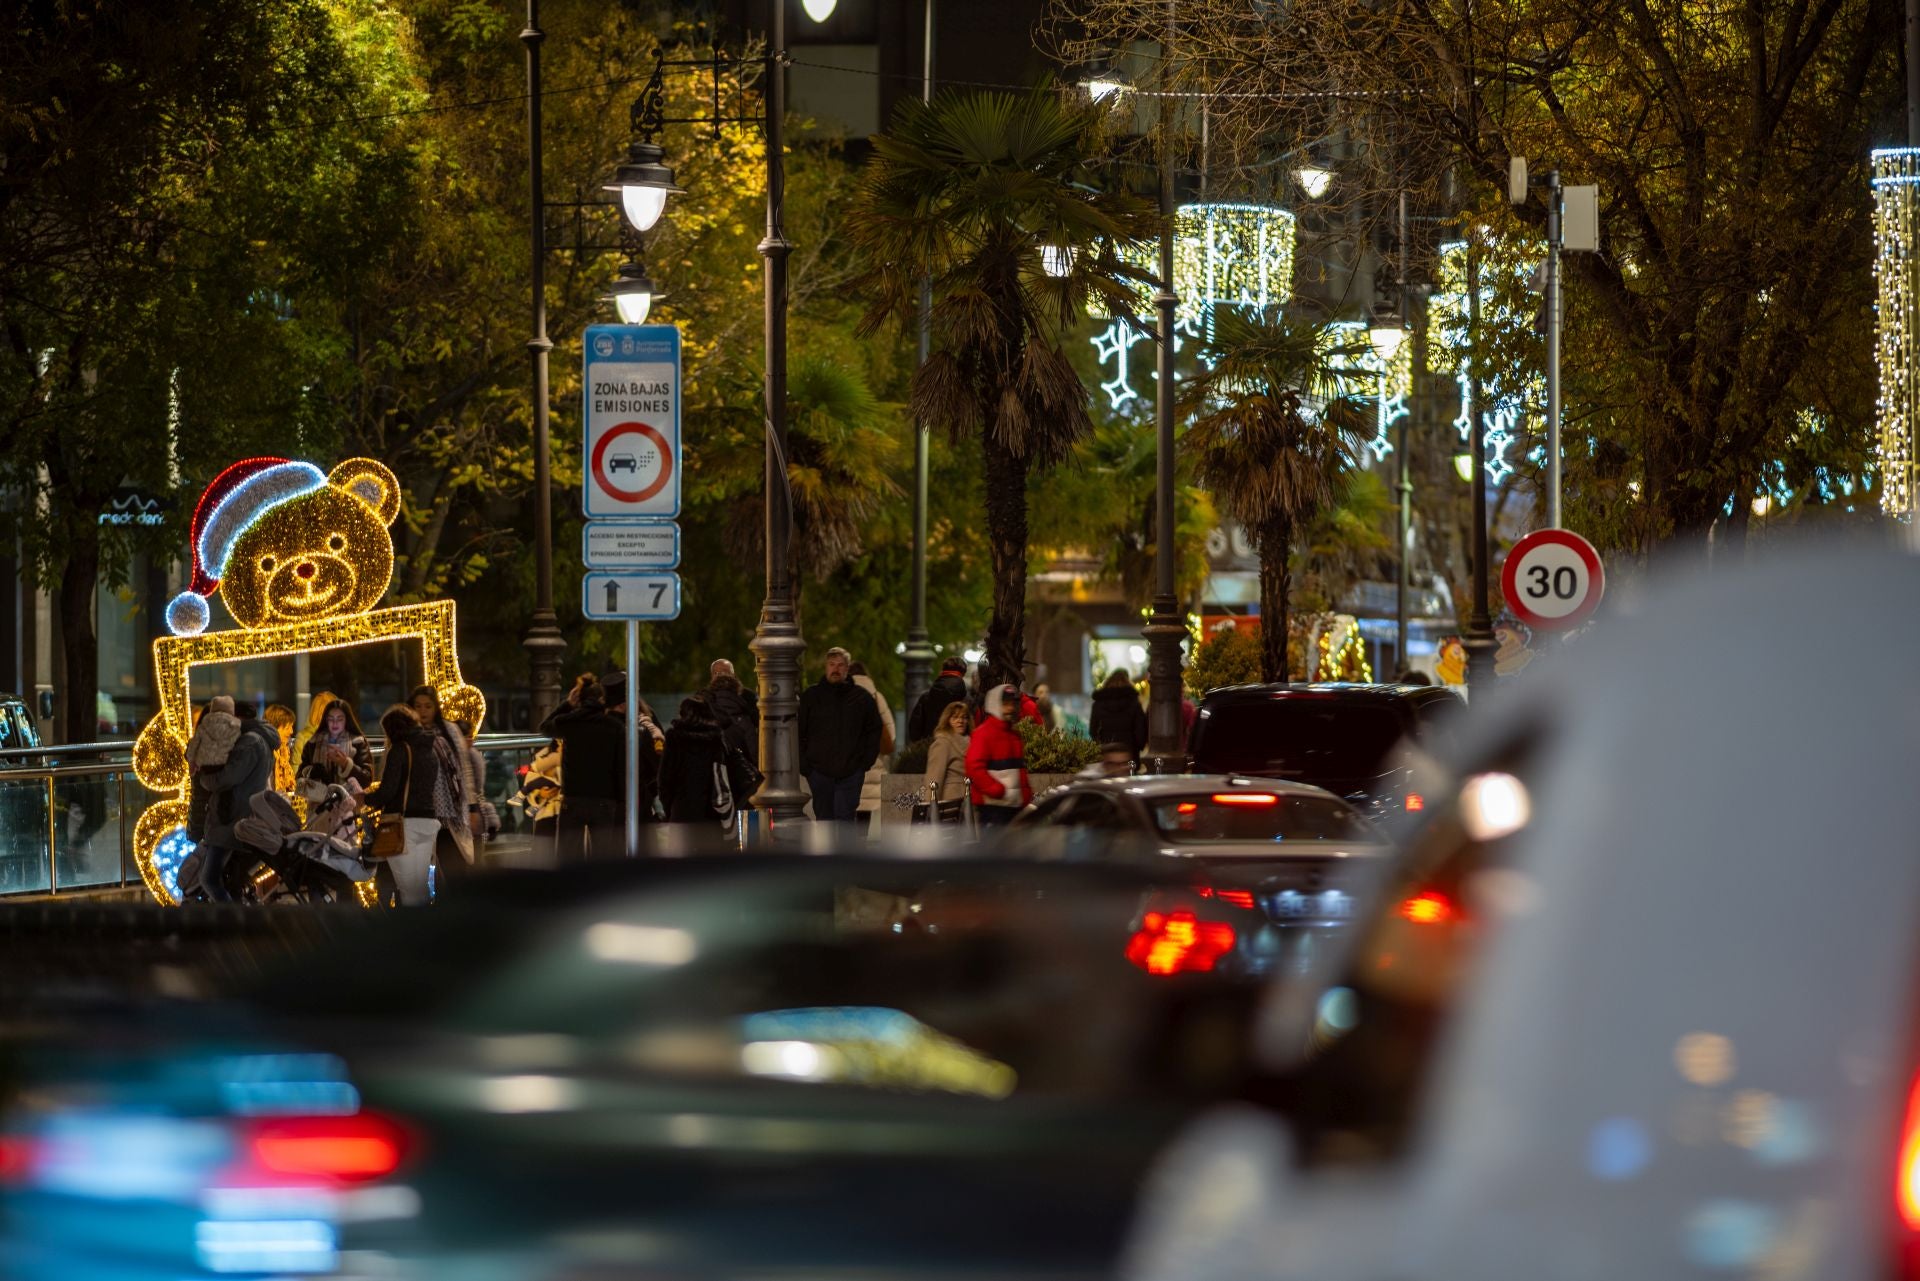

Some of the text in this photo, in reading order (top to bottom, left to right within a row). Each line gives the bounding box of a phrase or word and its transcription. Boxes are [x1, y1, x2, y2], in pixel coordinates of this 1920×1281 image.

[595, 383, 670, 396] ZONA BAJAS
[595, 400, 670, 413] EMISIONES
[1526, 565, 1577, 600] 30
[648, 583, 668, 609] 7
